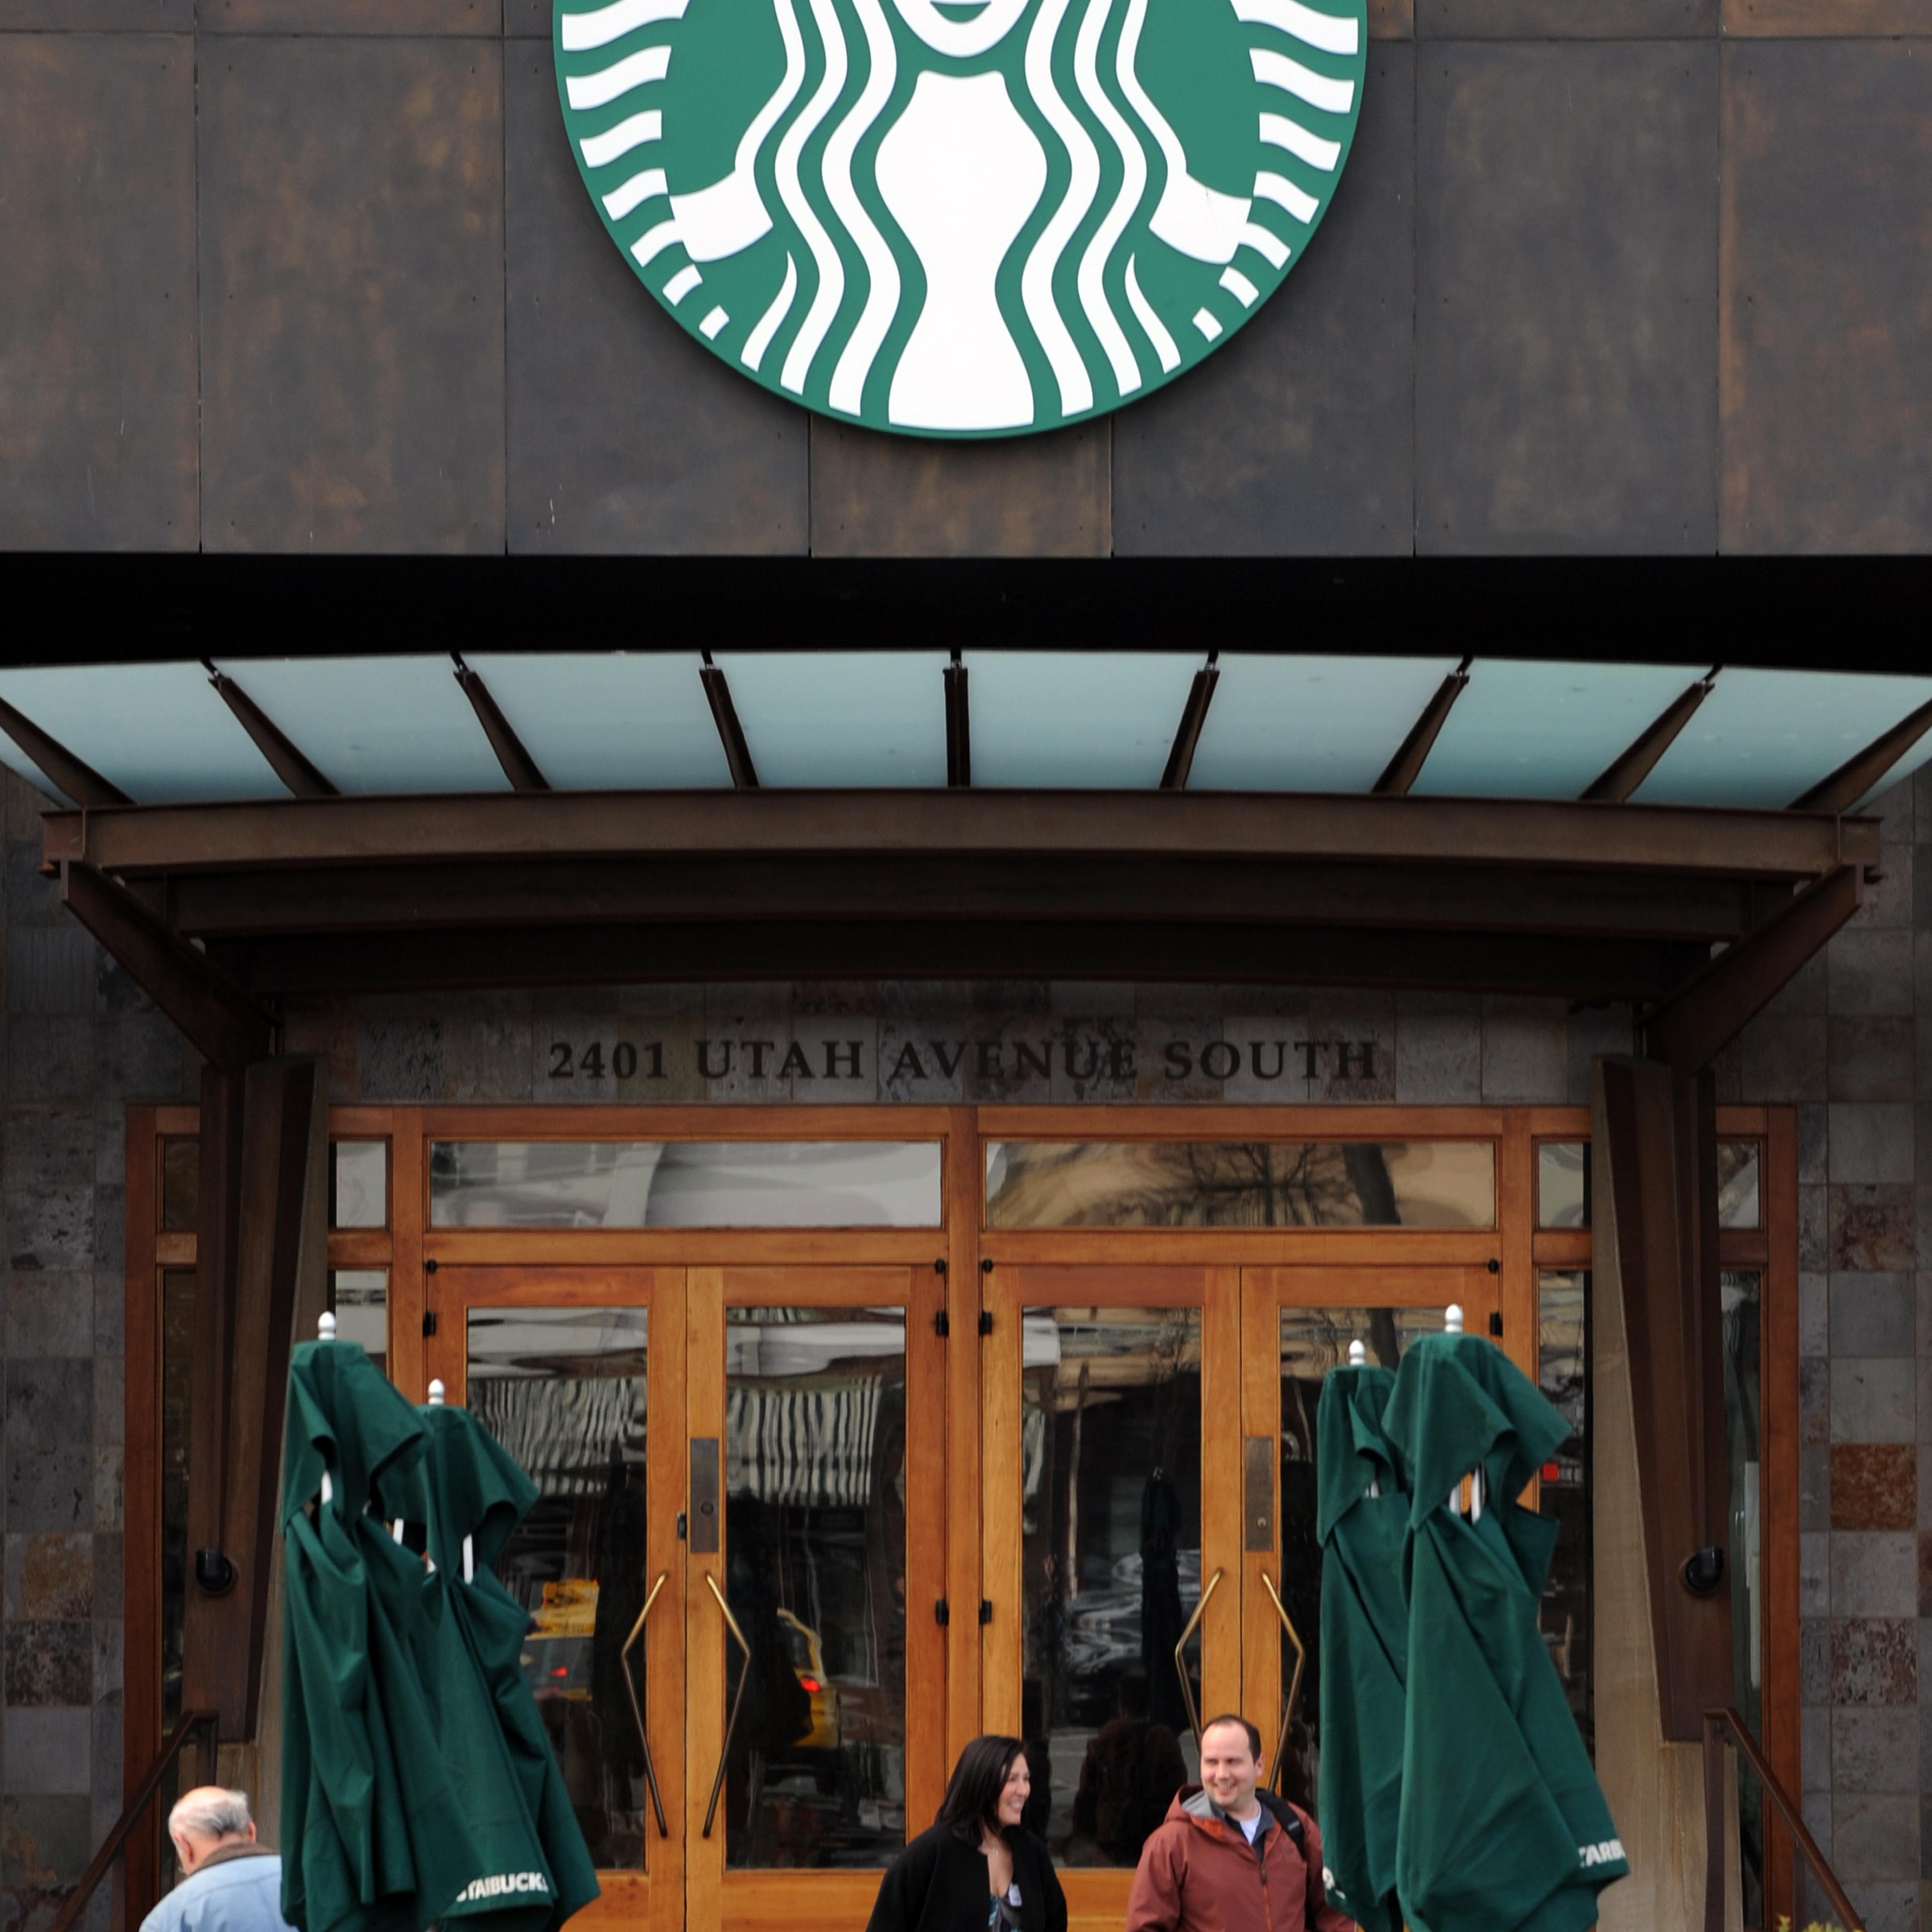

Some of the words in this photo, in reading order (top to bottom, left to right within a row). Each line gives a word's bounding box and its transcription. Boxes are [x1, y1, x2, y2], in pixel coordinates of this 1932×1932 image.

[548, 1041, 668, 1079] 2401
[696, 1040, 864, 1079] UTAH
[892, 1040, 1136, 1079] AVENUE
[1164, 1040, 1376, 1079] SOUTH
